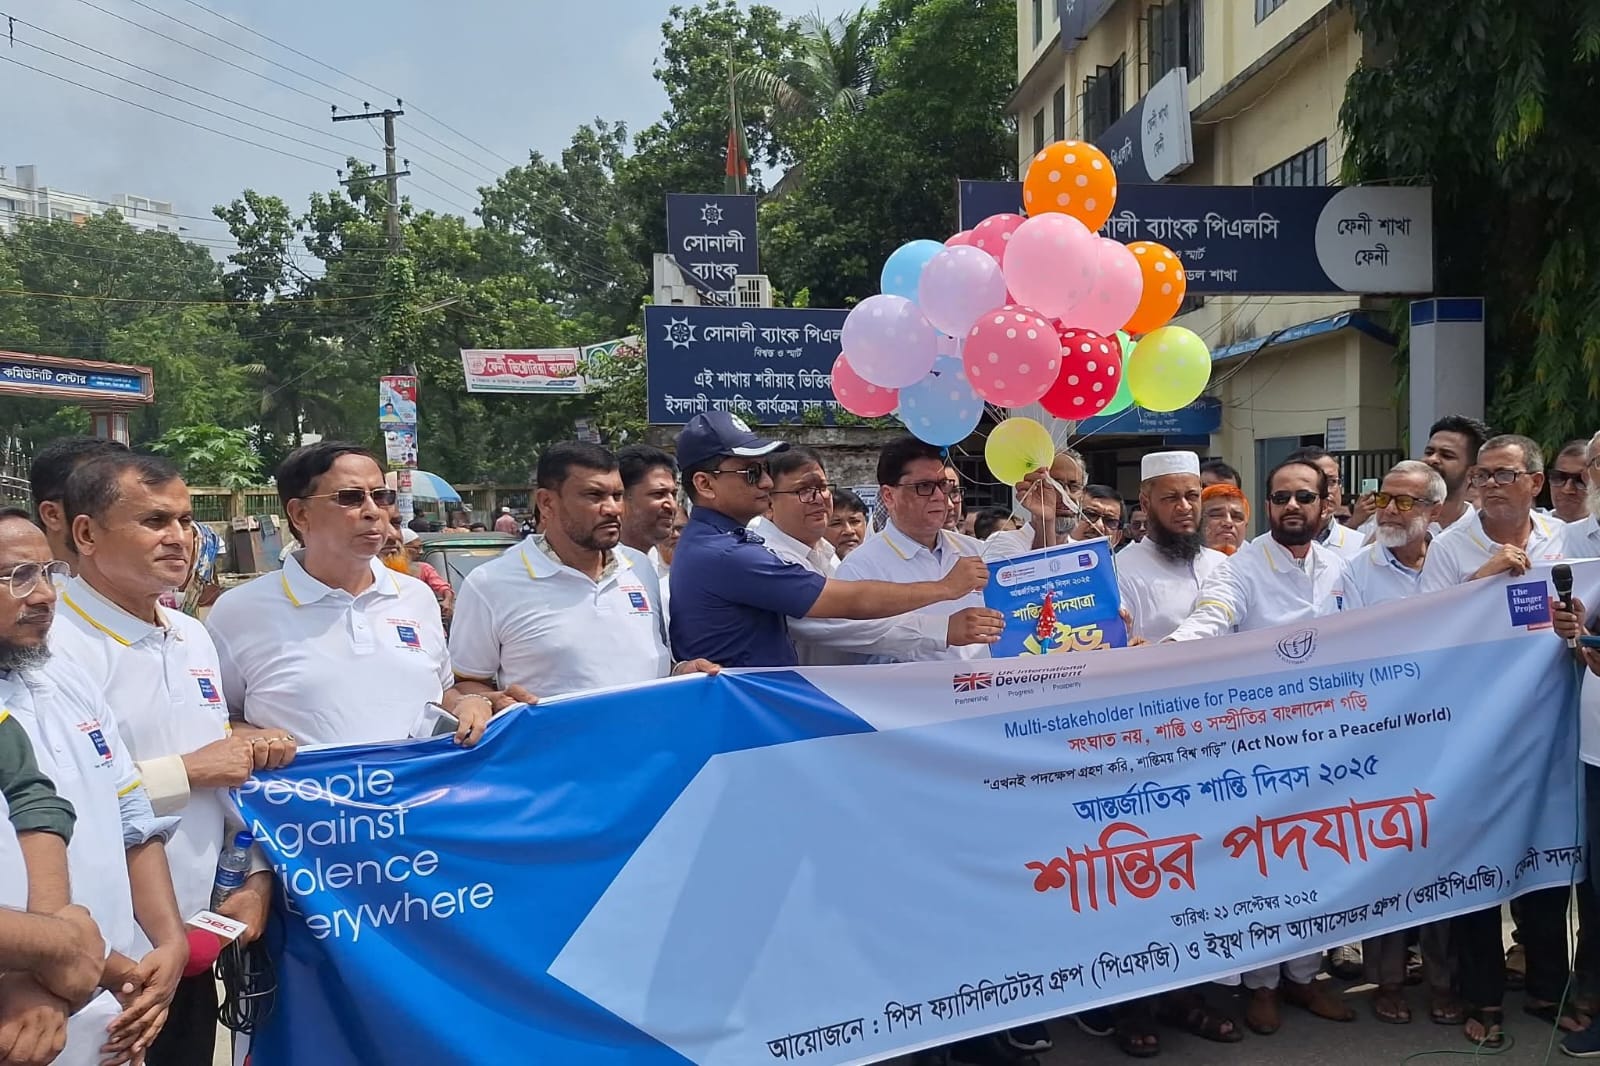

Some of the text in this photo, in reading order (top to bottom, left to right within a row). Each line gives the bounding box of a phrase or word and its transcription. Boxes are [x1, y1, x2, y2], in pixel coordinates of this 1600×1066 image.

[1100, 210, 1280, 240] নালী ব্যাংক পিএলসি
[1337, 212, 1412, 236] ফেনী শাখা
[683, 230, 746, 253] সোনালী
[1355, 243, 1390, 267] ফেনী
[690, 261, 739, 281] ব্যাংক
[1184, 268, 1238, 282] ডল শাখা
[703, 322, 843, 344] সোনালী ব্যাংক পিএল
[3, 366, 53, 381] কমিউনিটি
[694, 368, 714, 389] এই
[717, 371, 752, 388] শাখায়
[754, 367, 796, 390] শরীয়াহ
[664, 393, 709, 414] ইসলামী
[755, 394, 799, 414] কার্যক্রম
[802, 399, 822, 413] চাল
[1511, 588, 1528, 596] The
[1513, 595, 1543, 605] Hunger
[995, 671, 1082, 687] Development
[1017, 664, 1087, 674] International
[1004, 662, 1421, 738] Multi-stakeholder Initiative for Peace and Stability (MIPS)
[1067, 732, 1117, 753] সংঘাত
[1154, 718, 1187, 740] শান্তি
[1191, 720, 1203, 733] ও
[1206, 707, 1267, 732] সম্প্রীতির
[1271, 698, 1335, 721] বাংলাদেশ
[1340, 690, 1368, 711] গড়ি
[1030, 769, 1075, 785] পদক্ষেপ
[1077, 765, 1103, 779] গ্রহণ
[1136, 751, 1175, 768] শান্তিময়
[1177, 746, 1198, 761] বিশ্ব
[1231, 739, 1261, 755] (Act
[1264, 733, 1299, 748] Now
[1301, 728, 1324, 743] for
[1328, 727, 1338, 739] a
[1339, 715, 1401, 737] Peaceful
[1404, 707, 1451, 726] World)
[237, 764, 394, 808] People
[1072, 754, 1379, 823] আন্তর্জাতিক শান্তি দিবস ২০২৫
[252, 807, 409, 859] Against
[1024, 788, 1436, 914] শান্তির পদযাত্রা
[273, 850, 439, 896] iolence
[1214, 904, 1229, 920] ২১
[1233, 895, 1279, 916] সেপ্টেম্বর
[1284, 889, 1318, 908] ২০২৫
[767, 1017, 864, 1061] আয়োজনে
[884, 1001, 922, 1032] পিস
[927, 971, 1044, 1020] ফ্যাসিলিটেটর
[1049, 963, 1085, 992] গ্রুপ
[1091, 941, 1179, 989] (পিএফজি)
[1185, 942, 1201, 960] ও
[1249, 921, 1281, 949] পিস
[1286, 903, 1369, 939] অ্যাম্বাসেডর
[1371, 892, 1402, 918] গ্রুপ
[1542, 845, 1583, 867] সদর
